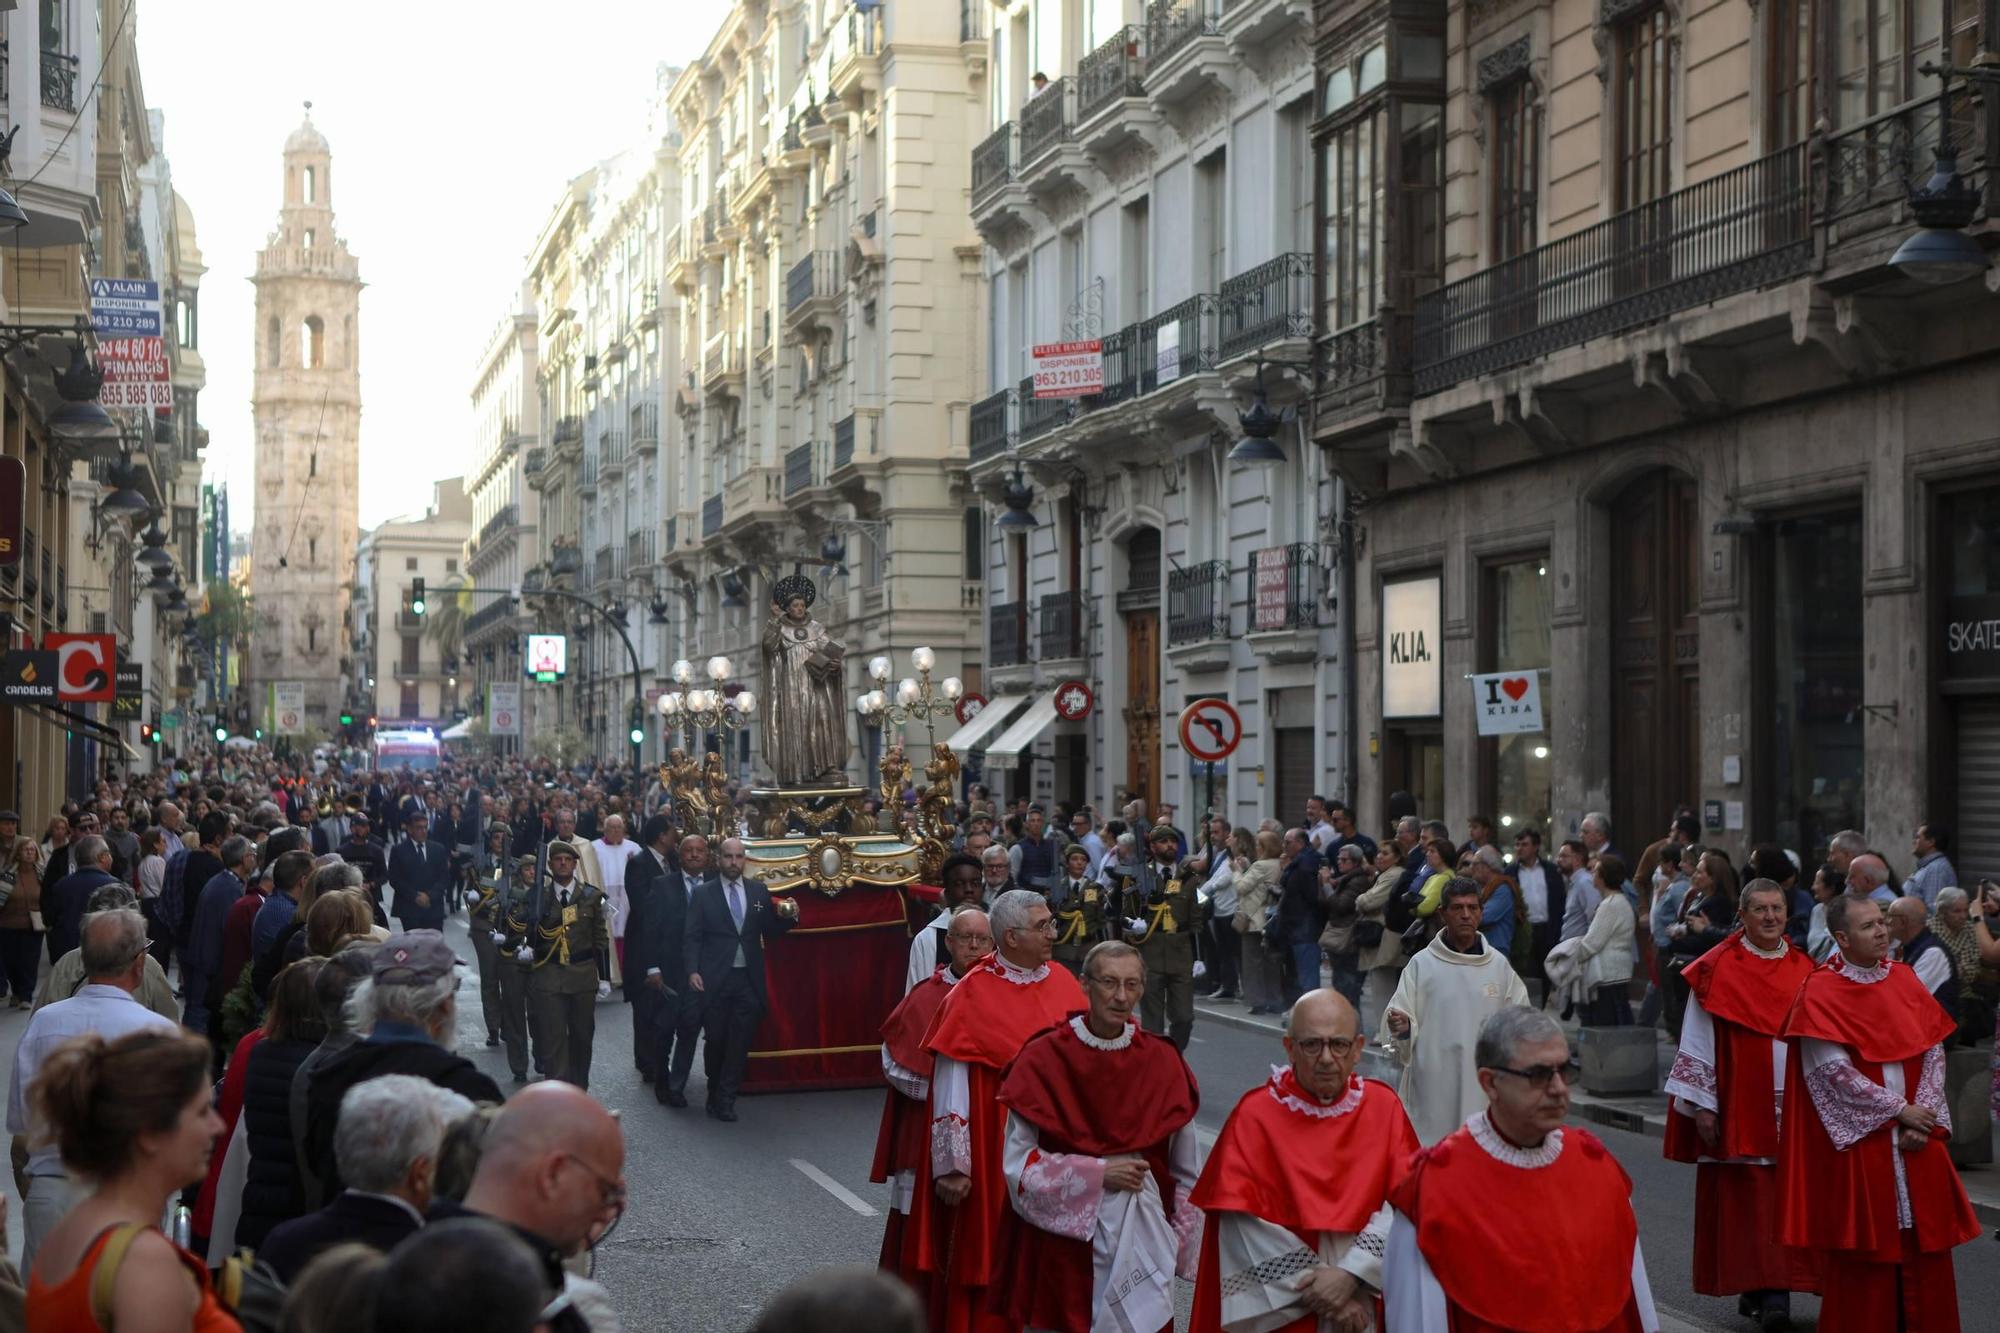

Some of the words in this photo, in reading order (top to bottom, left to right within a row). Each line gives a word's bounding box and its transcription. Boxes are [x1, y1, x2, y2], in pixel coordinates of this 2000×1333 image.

[112, 282, 146, 293] ALAIN
[95, 299, 147, 310] DISPONIBLE
[113, 316, 133, 328] 210
[136, 318, 156, 329] 289
[132, 339, 146, 359] 60
[147, 338, 161, 362] 10
[1040, 356, 1097, 369] DISPONIBLE
[1034, 371, 1057, 387] 963
[1059, 369, 1080, 385] 210
[1082, 367, 1102, 383] 305
[101, 384, 123, 405] 655
[126, 384, 147, 405] 585
[151, 384, 171, 404] 083
[1390, 630, 1431, 664] KLIA.
[5, 685, 54, 697] CANDELAS
[1484, 679, 1502, 704] I
